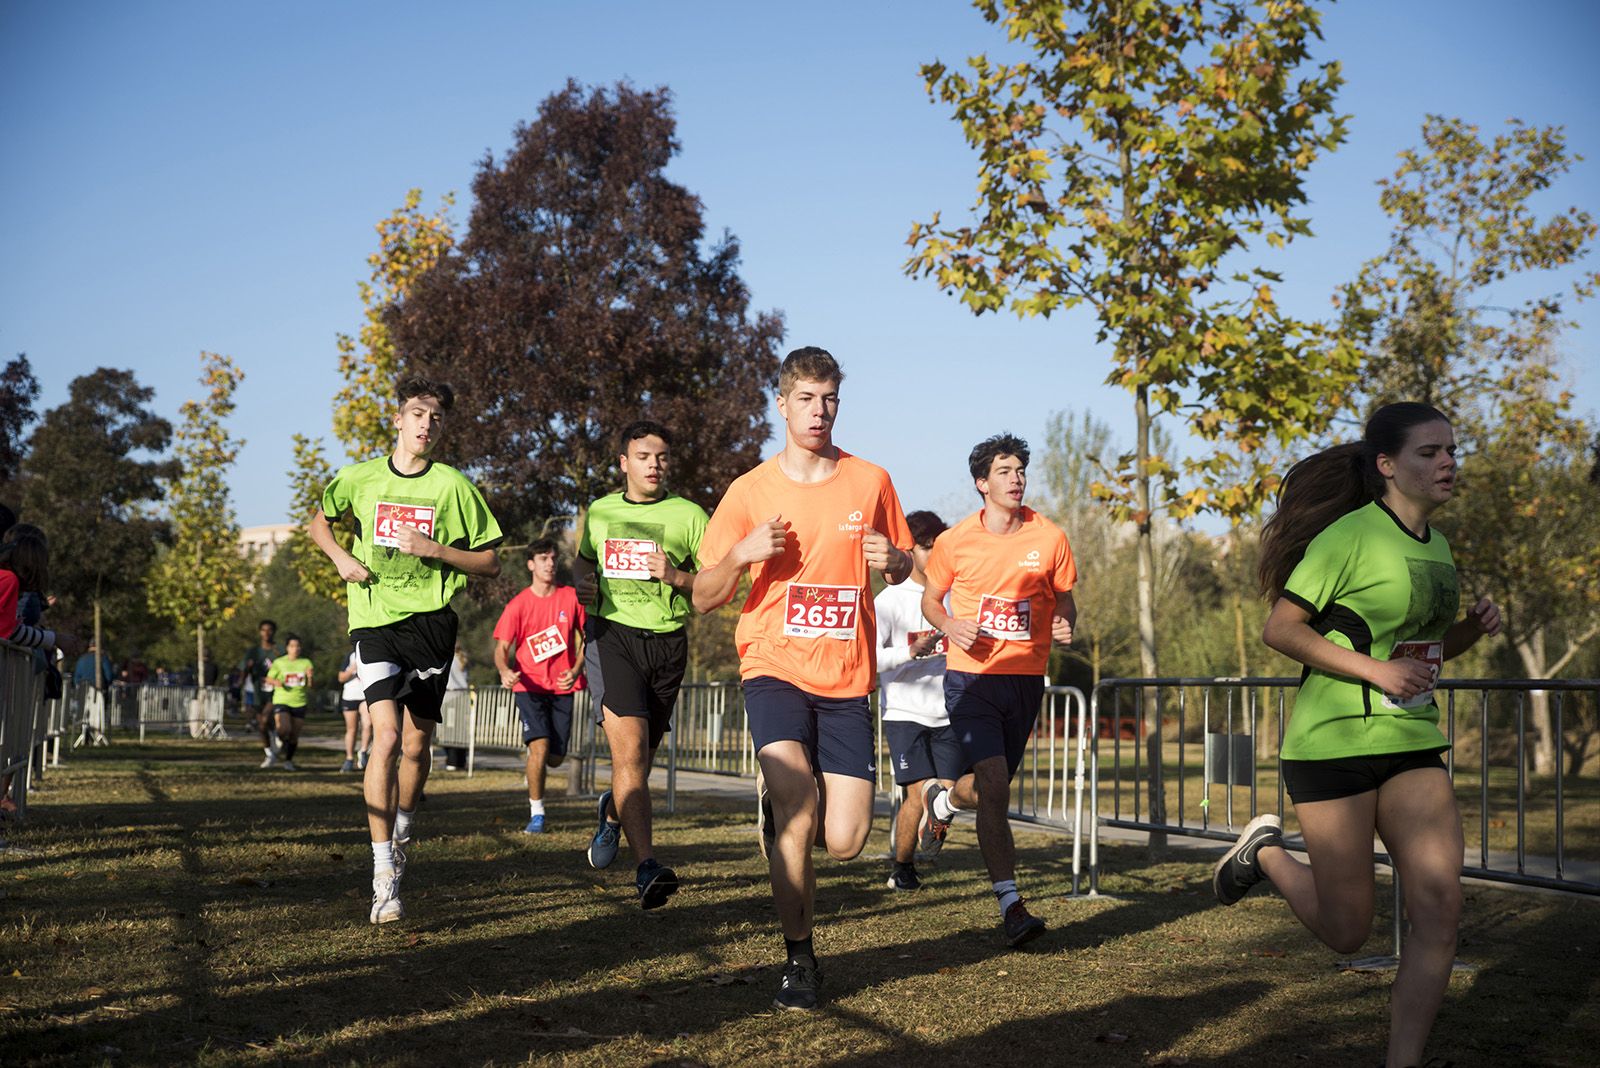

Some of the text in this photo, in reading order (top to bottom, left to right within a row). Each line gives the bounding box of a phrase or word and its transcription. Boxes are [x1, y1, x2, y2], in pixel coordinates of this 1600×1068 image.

[378, 519, 430, 538] 458
[790, 604, 854, 628] 2657
[981, 611, 1028, 632] 2663
